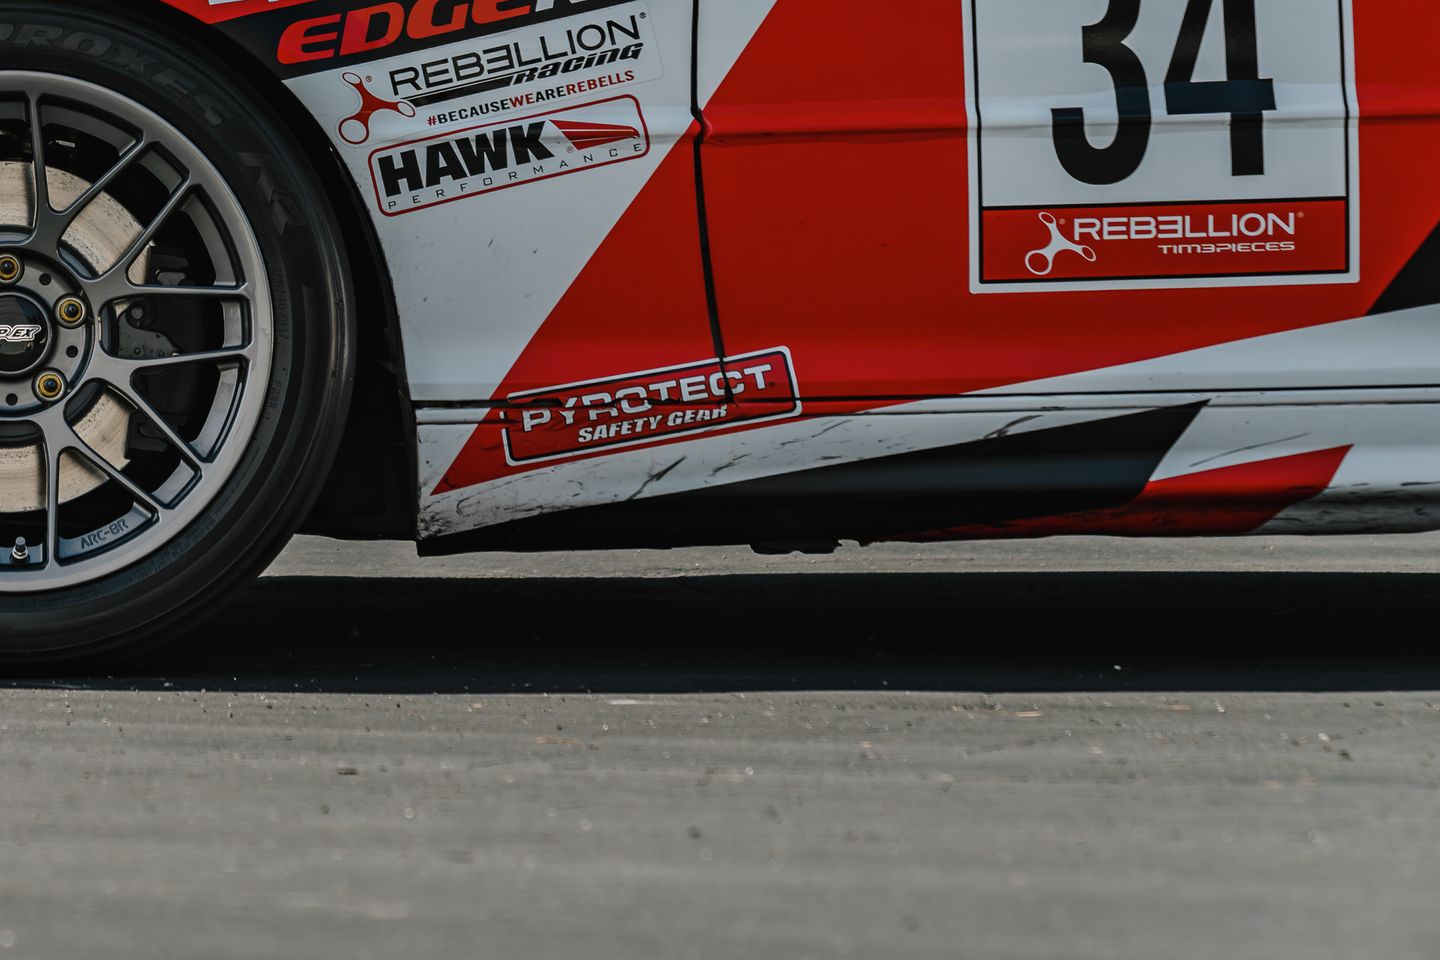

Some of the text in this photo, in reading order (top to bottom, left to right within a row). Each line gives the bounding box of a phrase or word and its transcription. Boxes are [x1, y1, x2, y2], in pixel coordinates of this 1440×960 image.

[377, 120, 556, 198] HAWK
[388, 142, 643, 210] PERFORMANCE
[521, 363, 772, 432] PYROTECT
[578, 402, 728, 443] SAFETY GEAR
